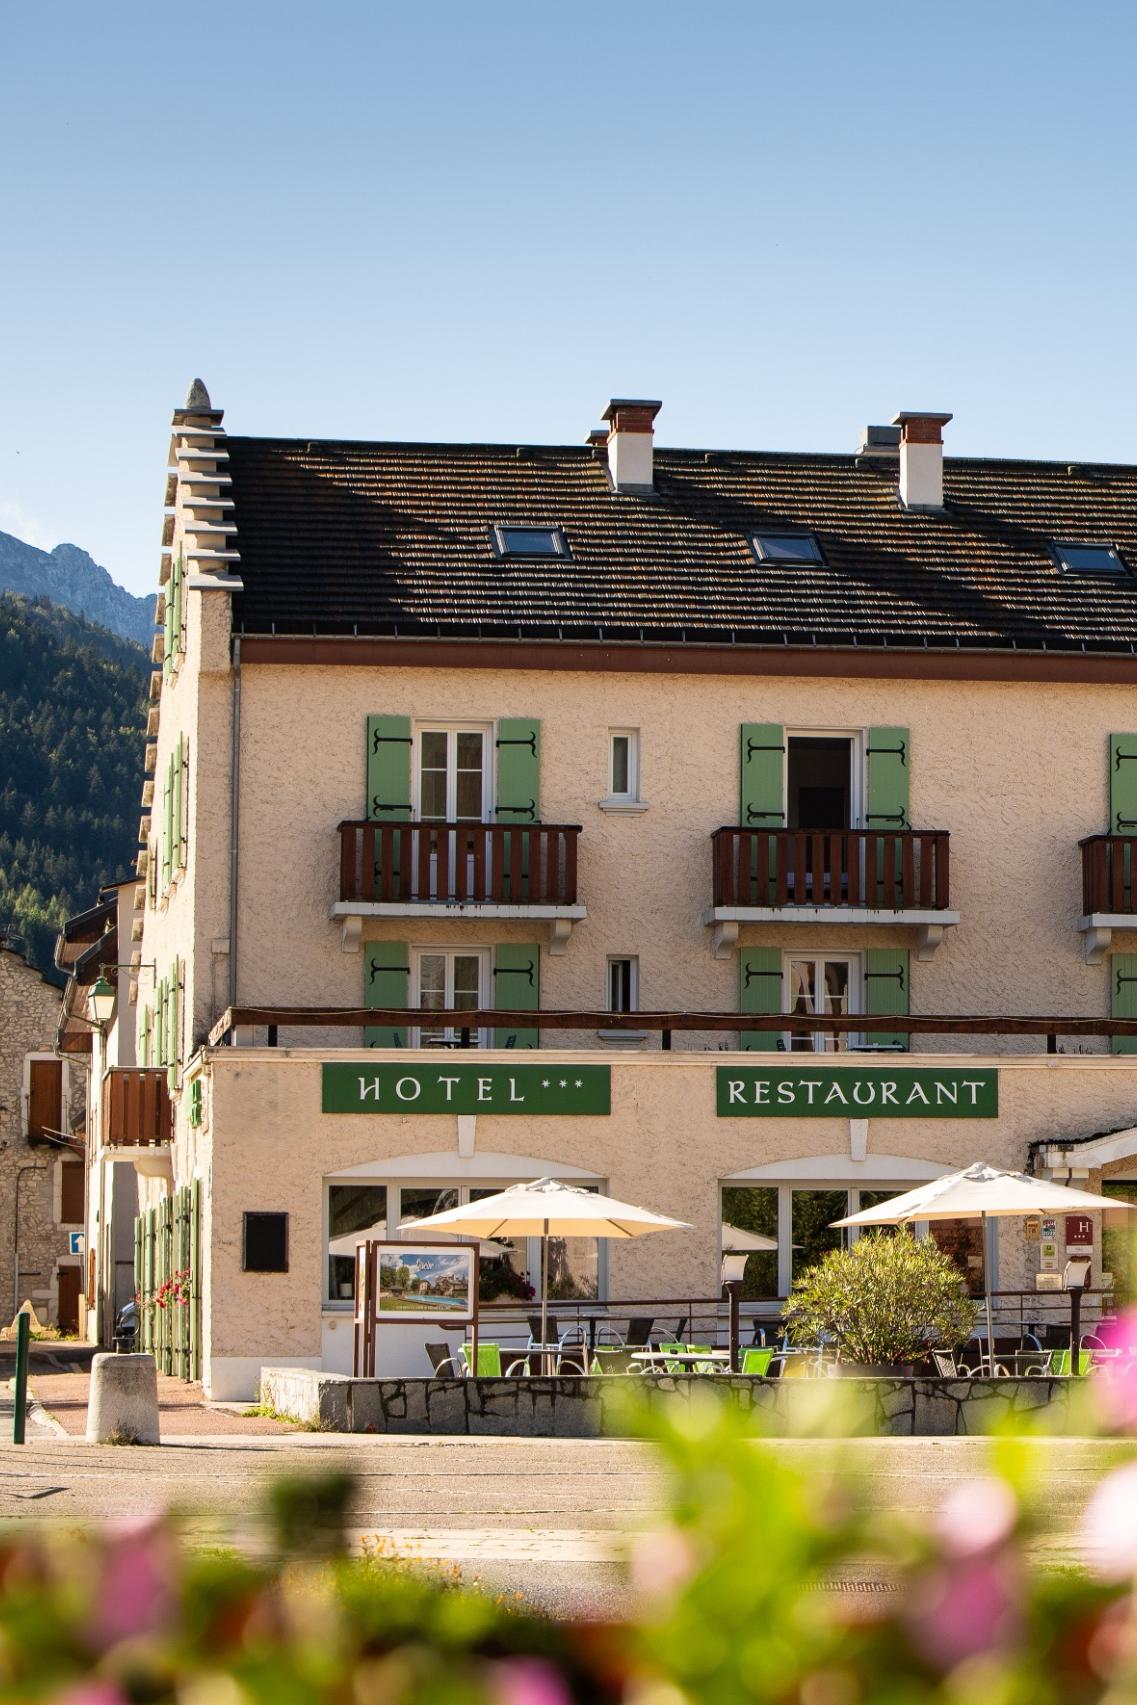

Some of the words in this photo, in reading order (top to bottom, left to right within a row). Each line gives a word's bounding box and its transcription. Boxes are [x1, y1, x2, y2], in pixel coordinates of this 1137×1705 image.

[357, 1076, 525, 1102] HOTEL
[728, 1080, 986, 1105] RESTAURANT
[1079, 1221, 1089, 1233] H
